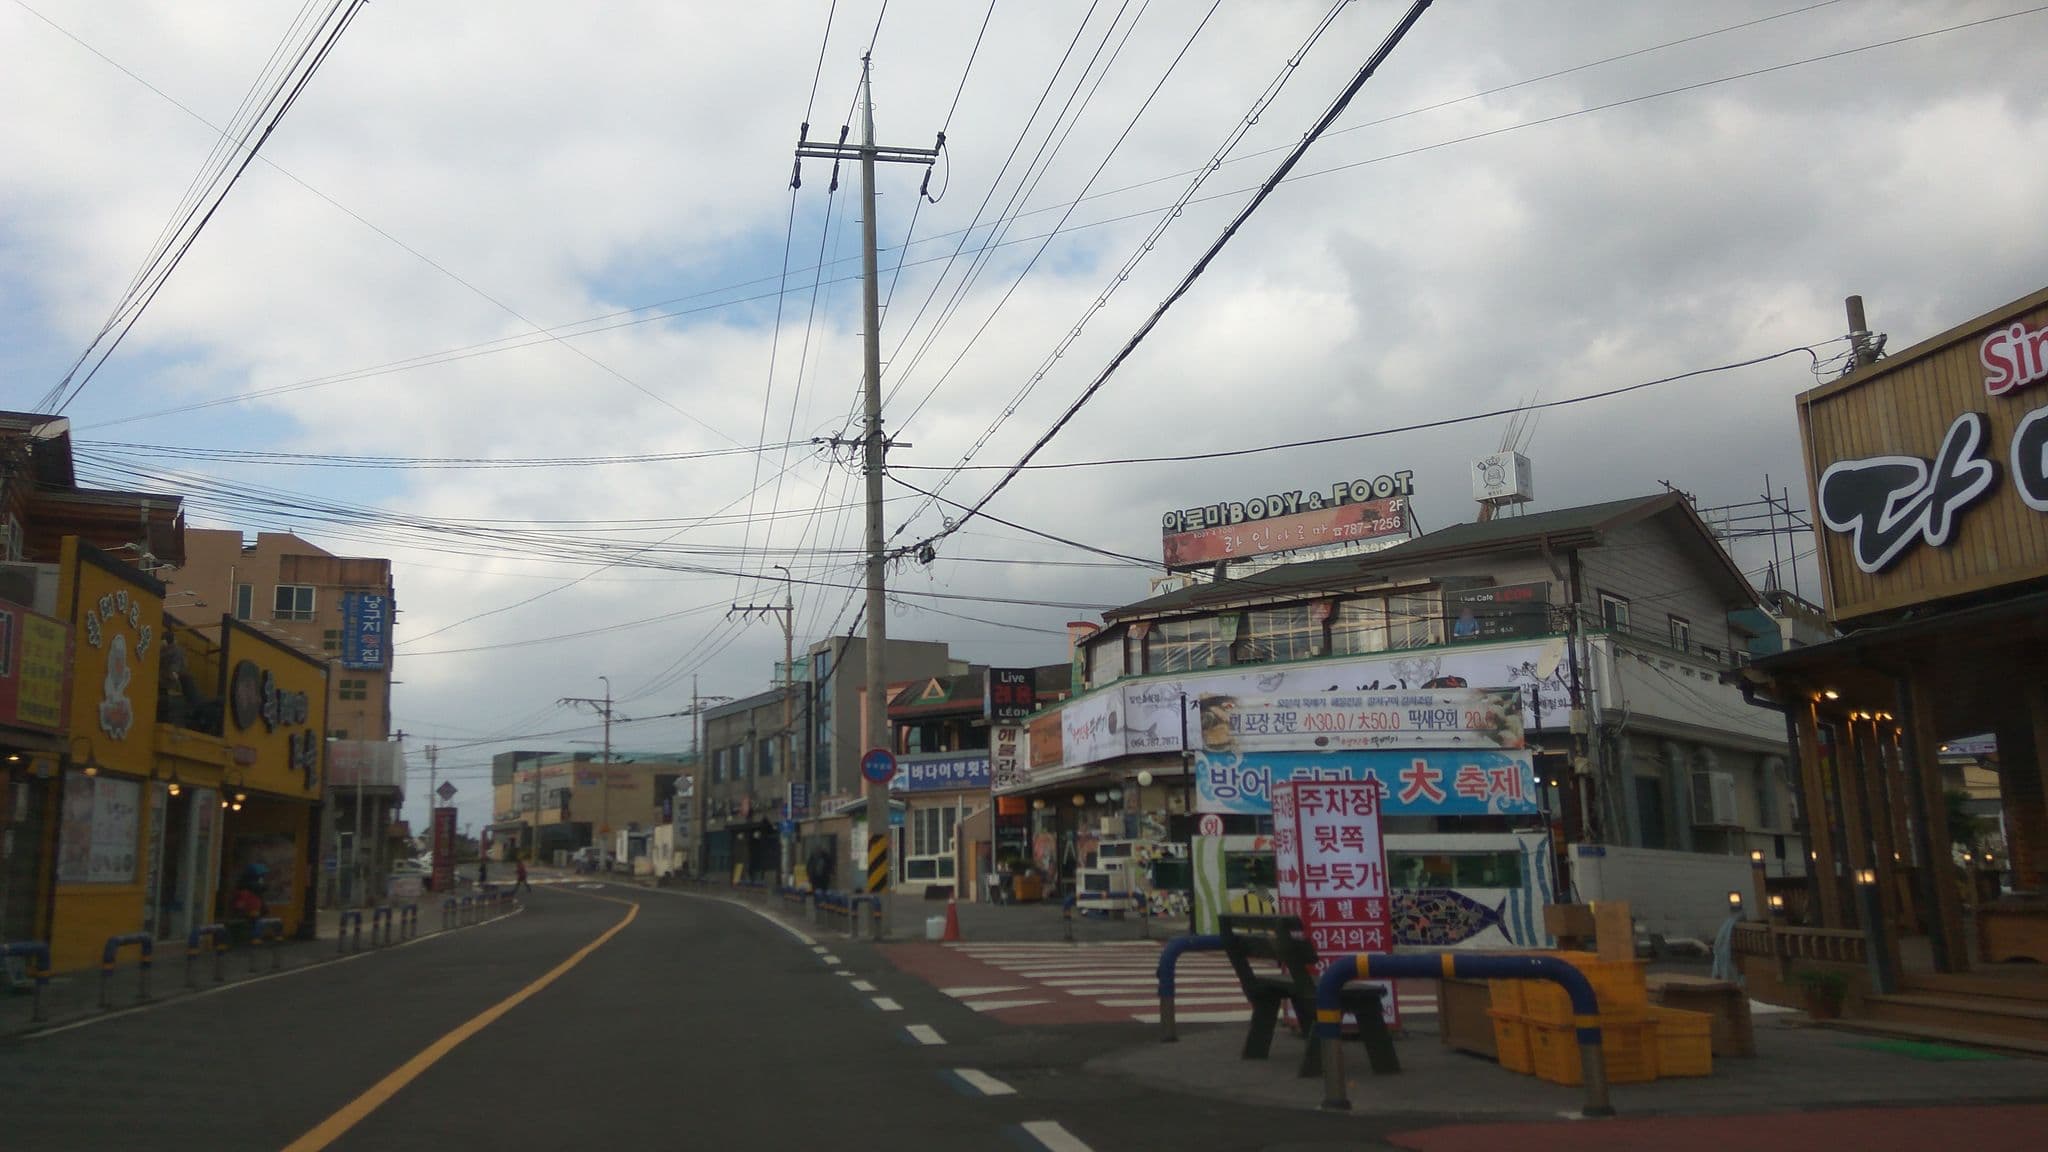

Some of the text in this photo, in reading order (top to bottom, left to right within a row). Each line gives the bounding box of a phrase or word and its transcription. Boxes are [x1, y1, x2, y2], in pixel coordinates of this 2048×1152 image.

[1309, 491, 1323, 511] &
[1333, 470, 1413, 506] FOOT
[1389, 499, 1404, 513] 2F
[1344, 516, 1401, 536] 787-7256
[1000, 671, 1025, 683] Live
[1246, 713, 1270, 733] 포장
[1273, 711, 1298, 733] 전문
[1408, 709, 1458, 730] 딱새우회
[1210, 767, 1272, 800] 방어
[1401, 759, 1445, 803] 大
[1456, 764, 1523, 801] 축제
[1300, 787, 1376, 818] 주차장
[1314, 825, 1365, 854] 뒷쪽
[1305, 862, 1381, 892] 부둣가
[1312, 928, 1384, 949] 입식의자
